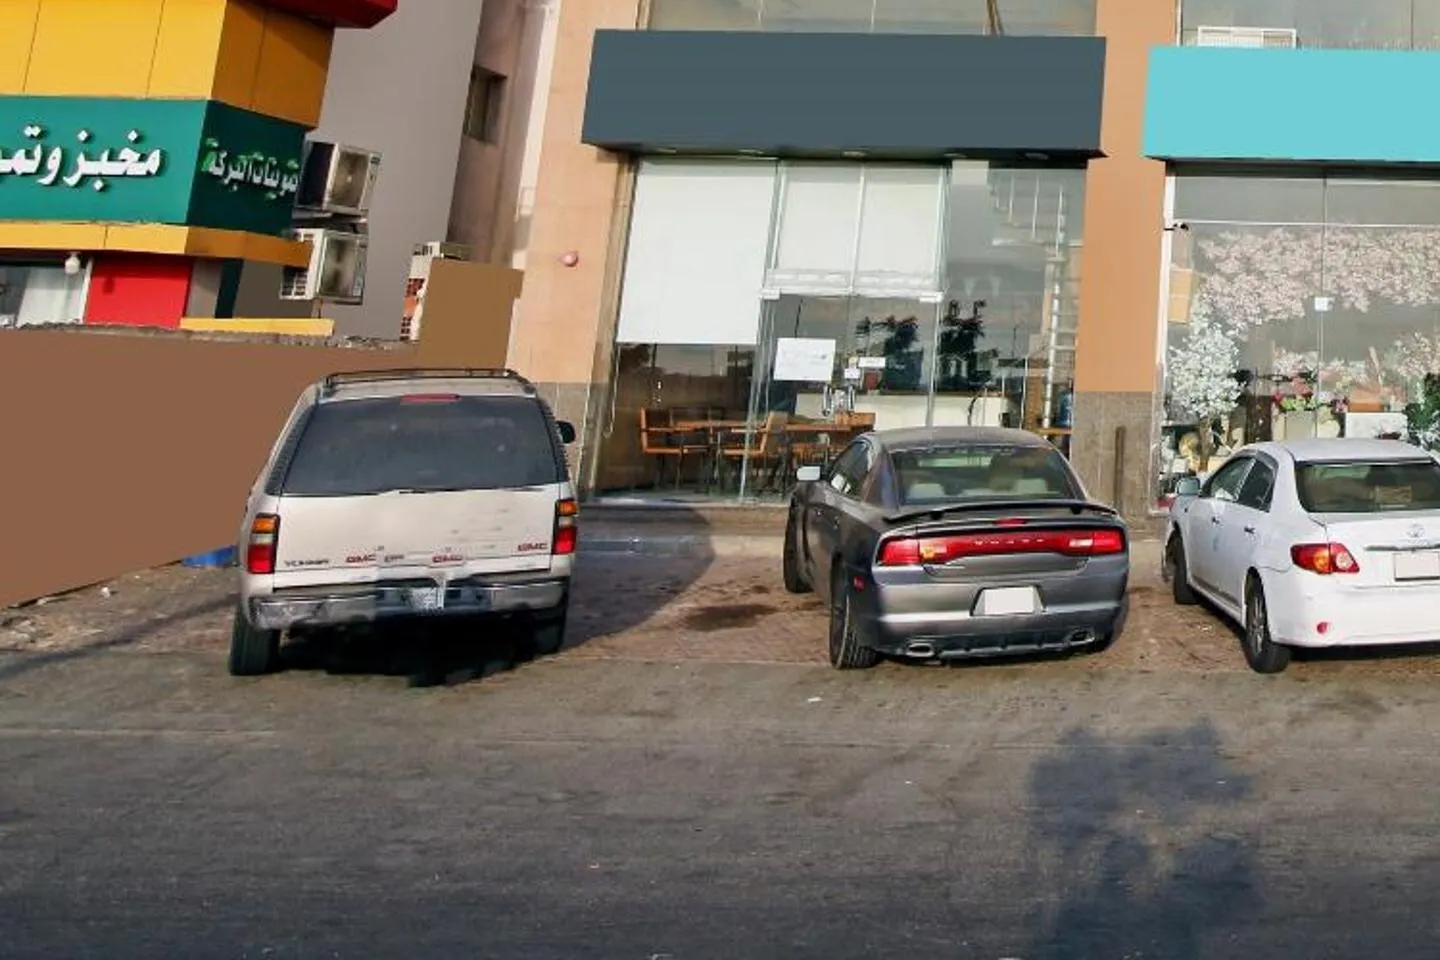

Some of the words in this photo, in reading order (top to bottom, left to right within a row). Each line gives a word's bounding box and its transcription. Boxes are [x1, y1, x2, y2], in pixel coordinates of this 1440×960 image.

[0, 125, 63, 186] وتم
[60, 129, 161, 191] مخبز
[346, 554, 376, 563] GMC
